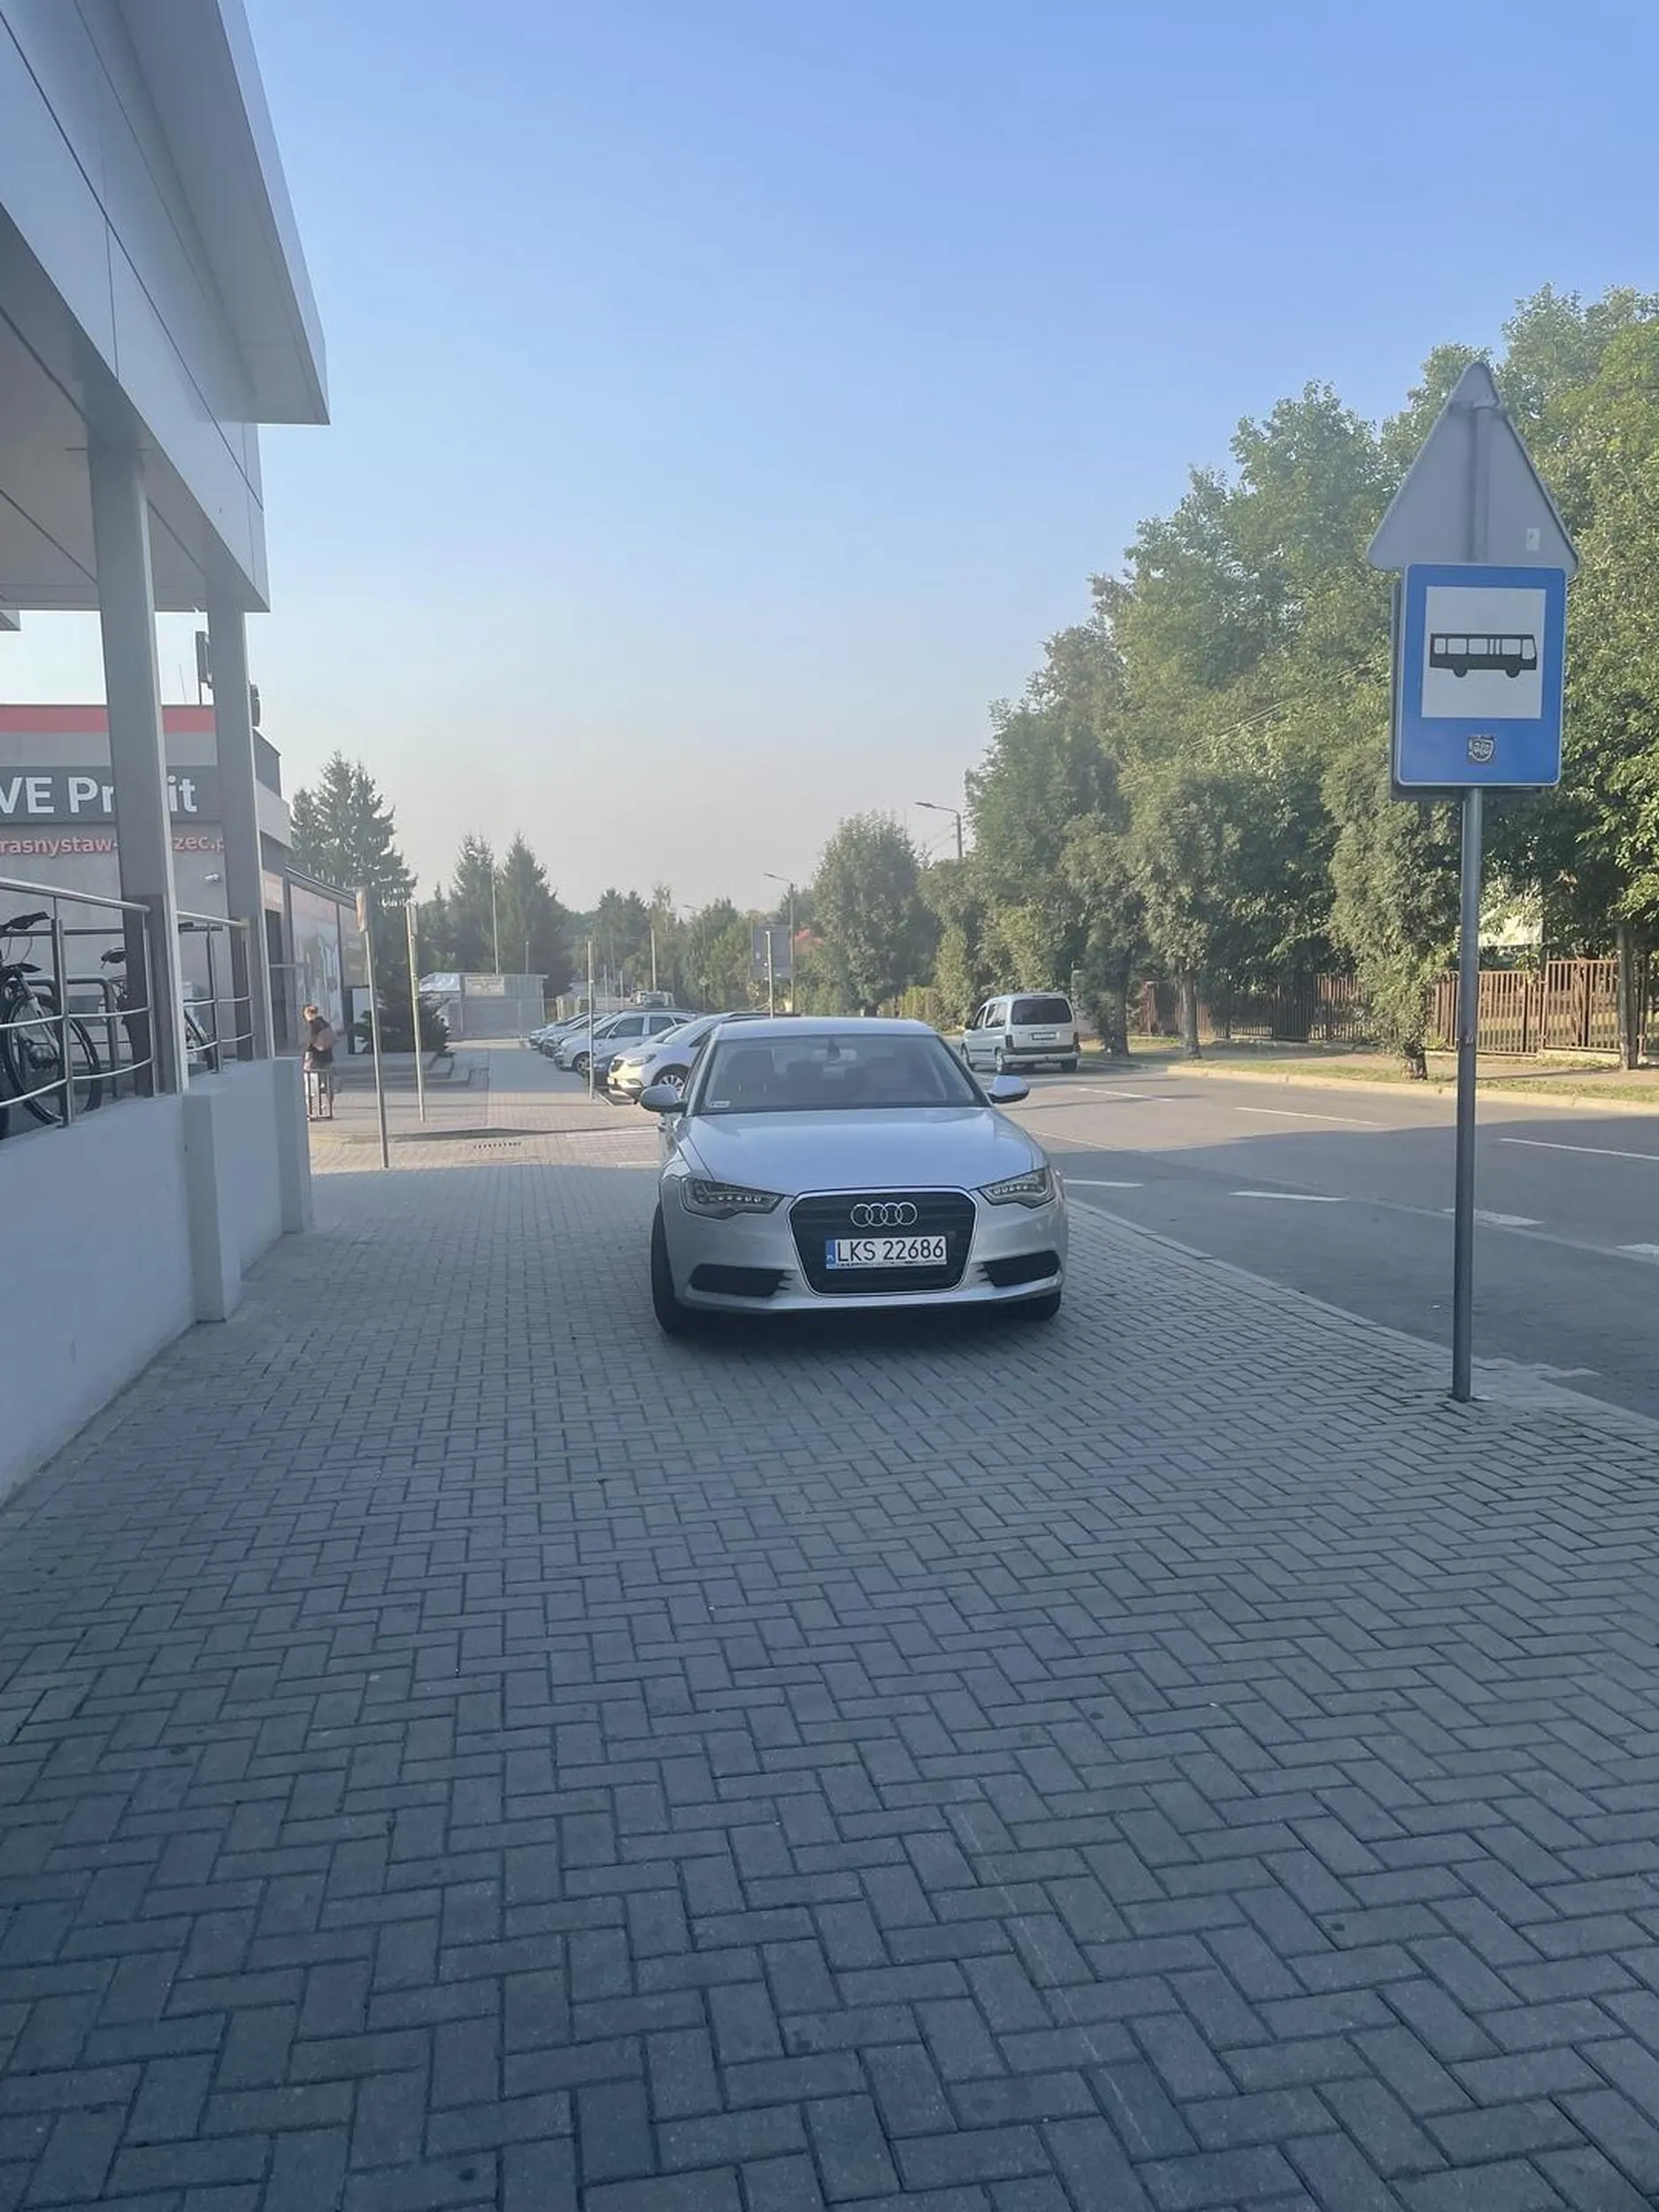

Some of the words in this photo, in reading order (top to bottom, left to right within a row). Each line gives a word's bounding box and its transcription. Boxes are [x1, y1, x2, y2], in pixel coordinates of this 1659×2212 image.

[68, 775, 197, 814] Prit
[837, 1240, 876, 1262] LKS
[882, 1238, 945, 1261] 22686
